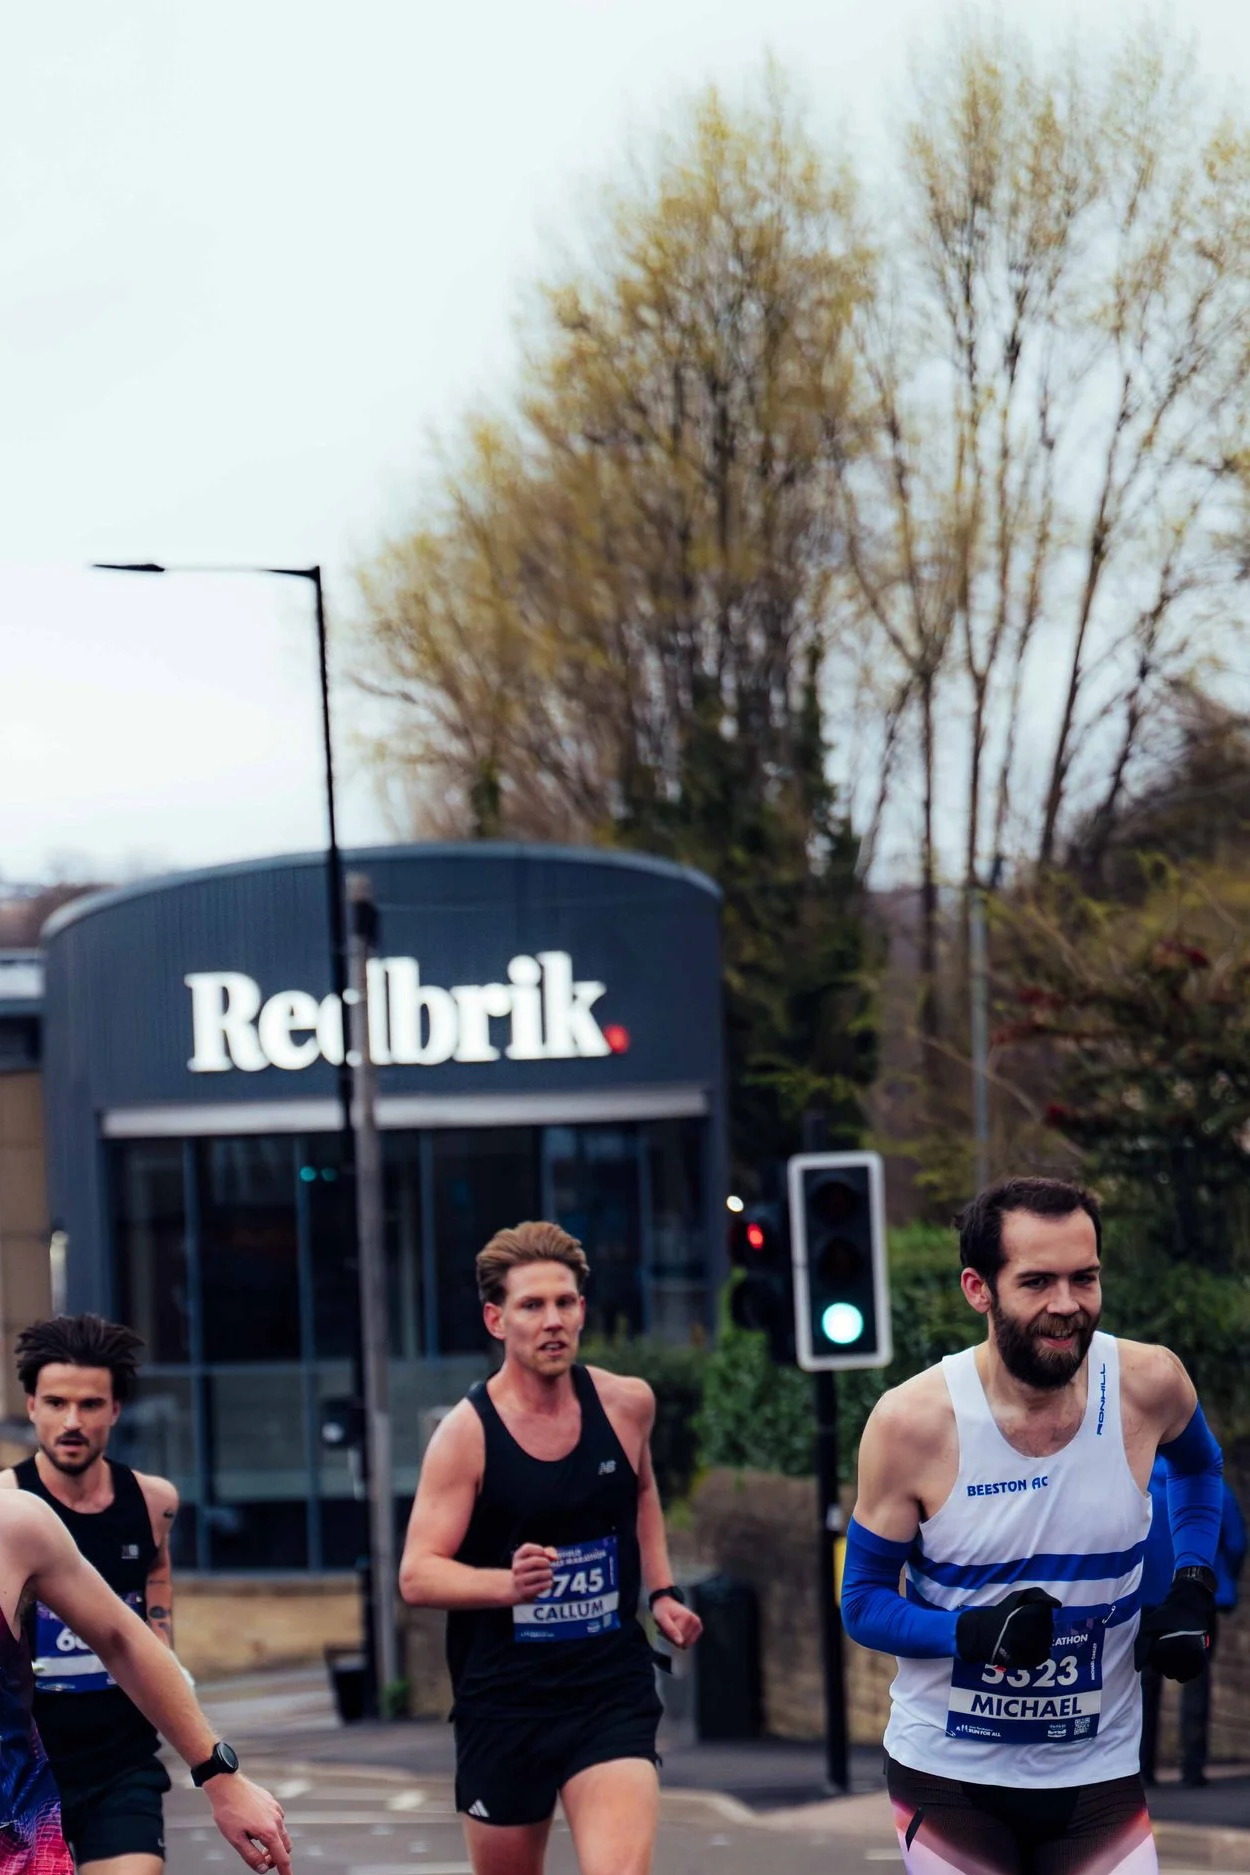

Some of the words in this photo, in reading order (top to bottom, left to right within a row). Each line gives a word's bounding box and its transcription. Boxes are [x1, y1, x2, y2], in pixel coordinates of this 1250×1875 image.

[1096, 1363, 1106, 1436] RONHILL
[967, 1479, 1027, 1497] BEESTON
[1031, 1476, 1049, 1490] AC
[537, 1567, 604, 1598] 745
[533, 1600, 604, 1621] CALLUM
[1052, 1633, 1088, 1647] ATHON
[970, 1694, 1082, 1718] MICHAEL
